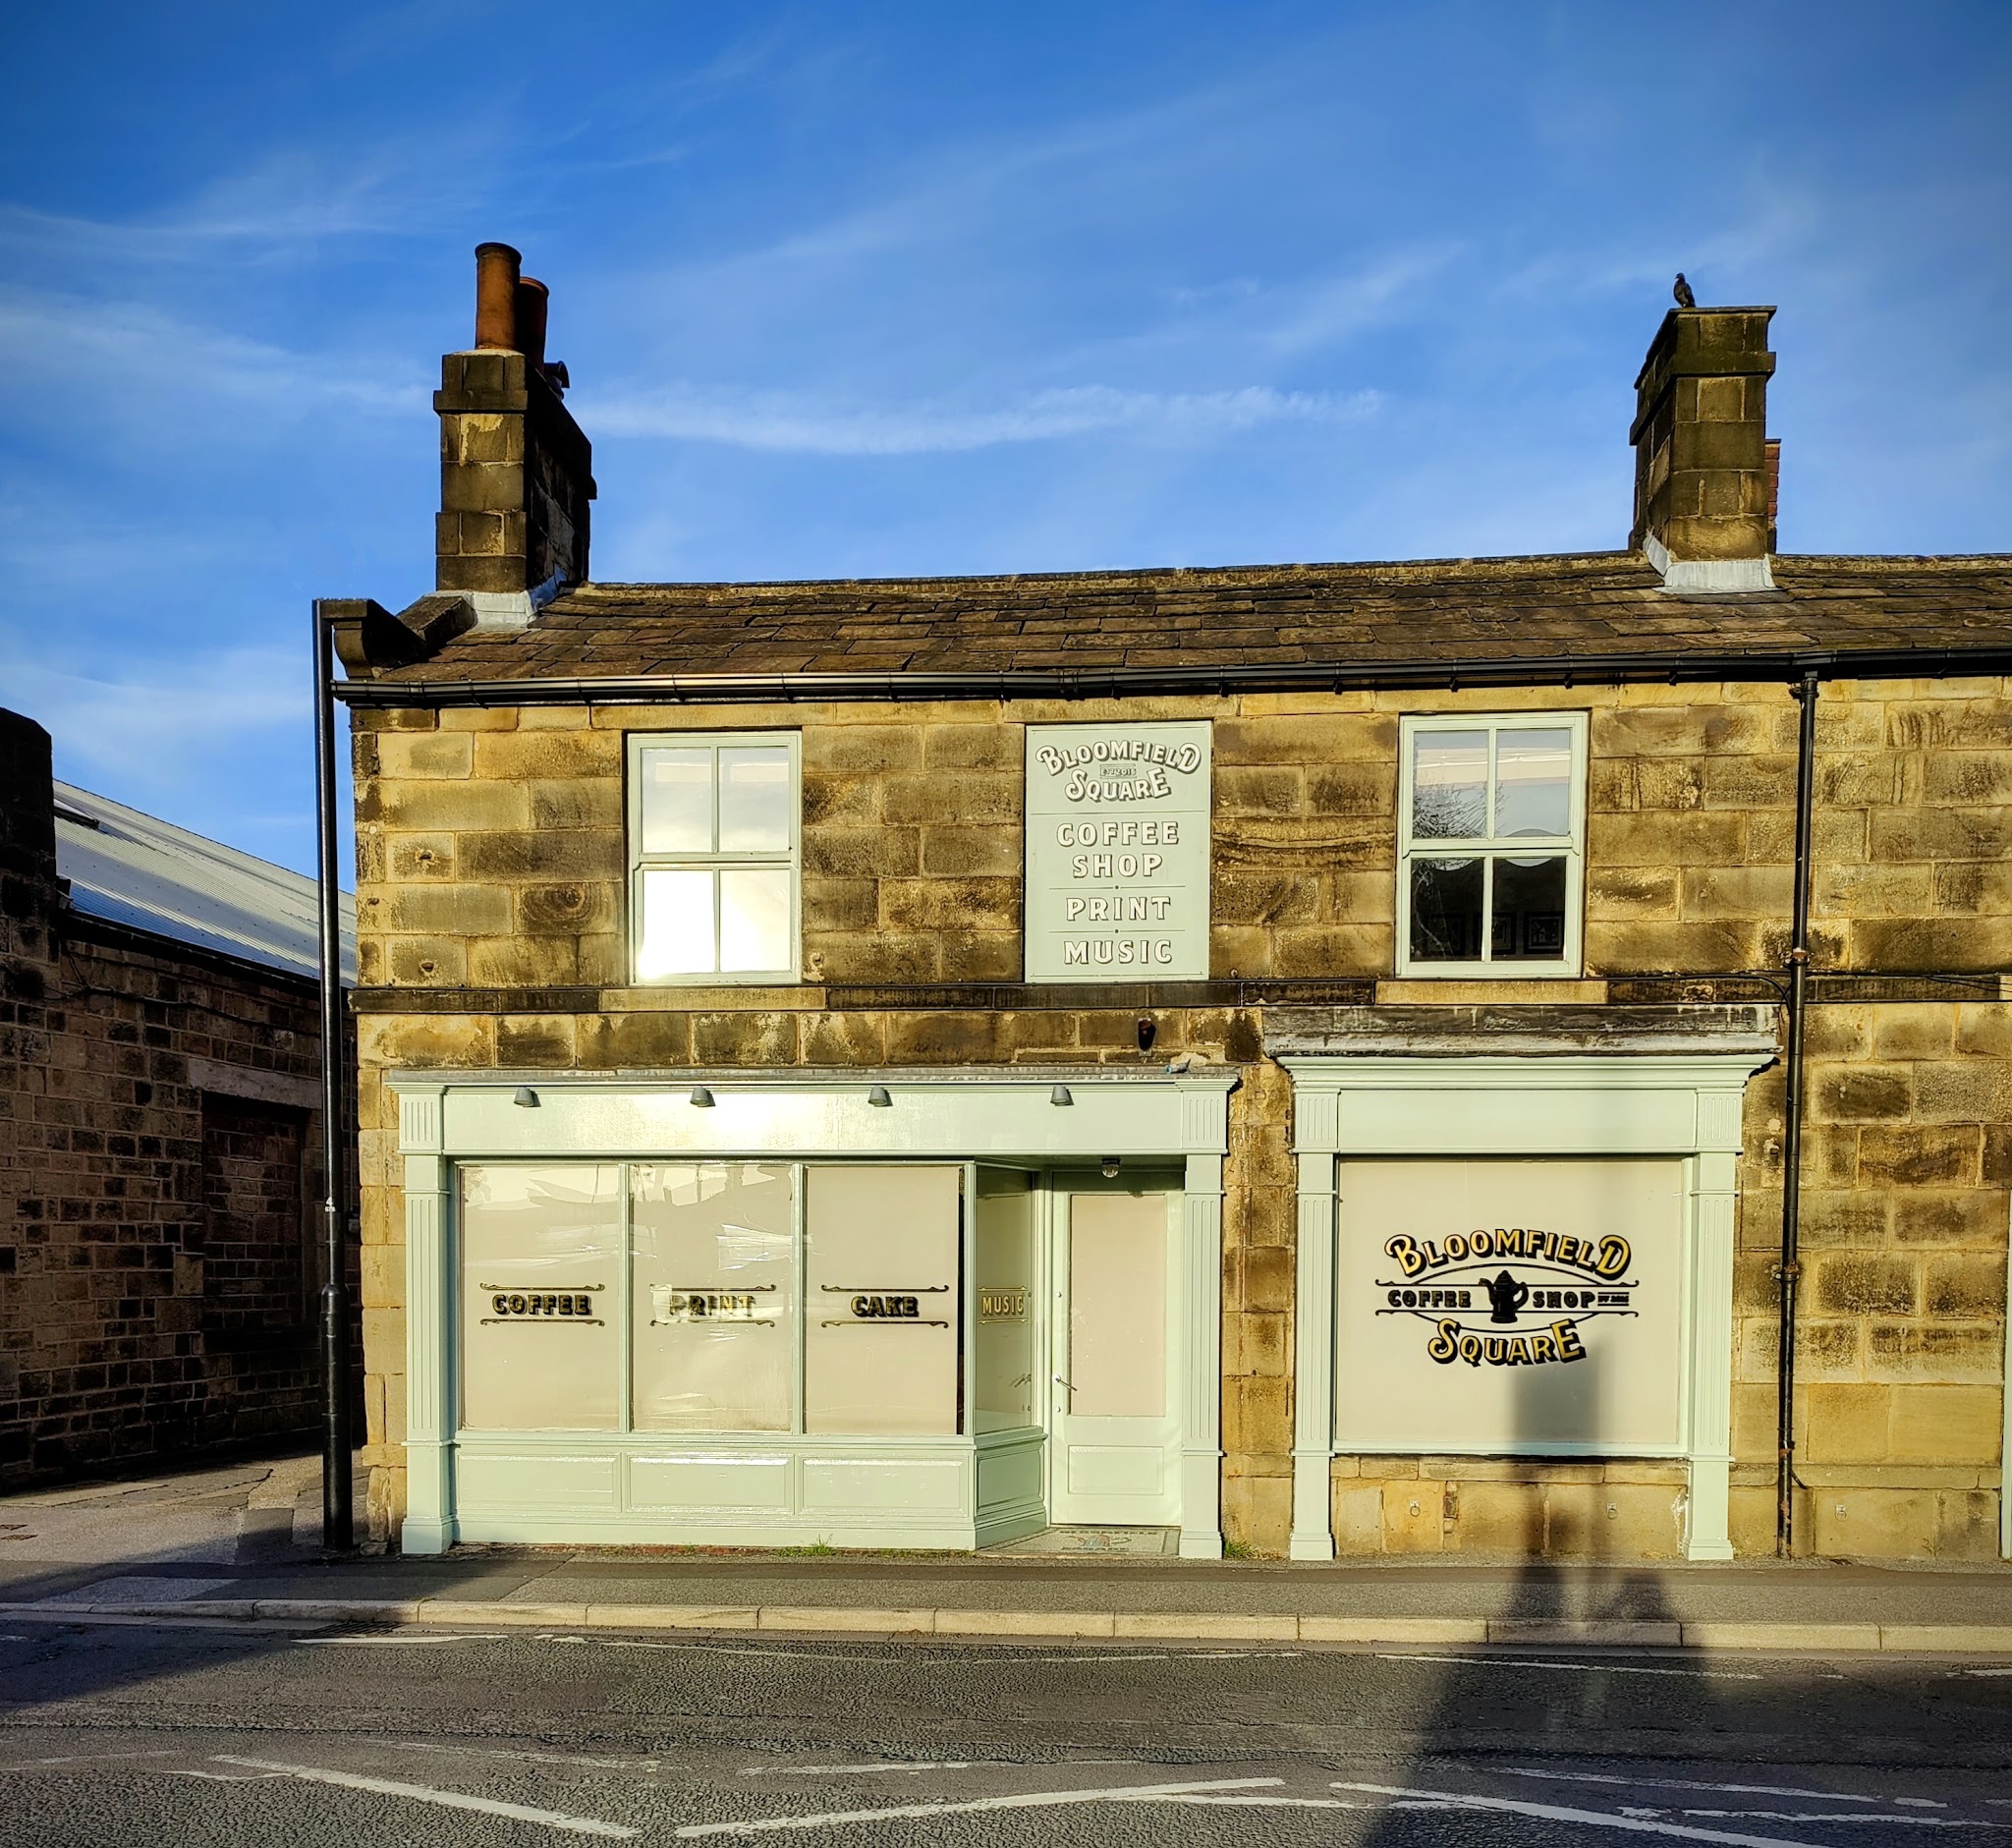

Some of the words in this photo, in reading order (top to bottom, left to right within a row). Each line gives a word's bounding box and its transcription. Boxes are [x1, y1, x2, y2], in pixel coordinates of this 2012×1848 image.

[1035, 740, 1202, 776] BLOOMFIELD
[1065, 767, 1172, 803] SQUARE
[1056, 821, 1180, 847] COFFEE
[1072, 853, 1163, 879] SHOP
[1066, 896, 1172, 922] PRINT
[1063, 939, 1173, 965] MUSIC
[1384, 1228, 1632, 1281] BLOOMFIELD
[491, 1294, 592, 1316] COFFEE
[669, 1295, 756, 1316] PRINT
[851, 1295, 920, 1317] CAKE
[982, 1295, 1025, 1316] MUSIC
[1387, 1289, 1472, 1309] COFFEE
[1533, 1290, 1596, 1309] SHOP
[1427, 1317, 1587, 1367] SQUARE
